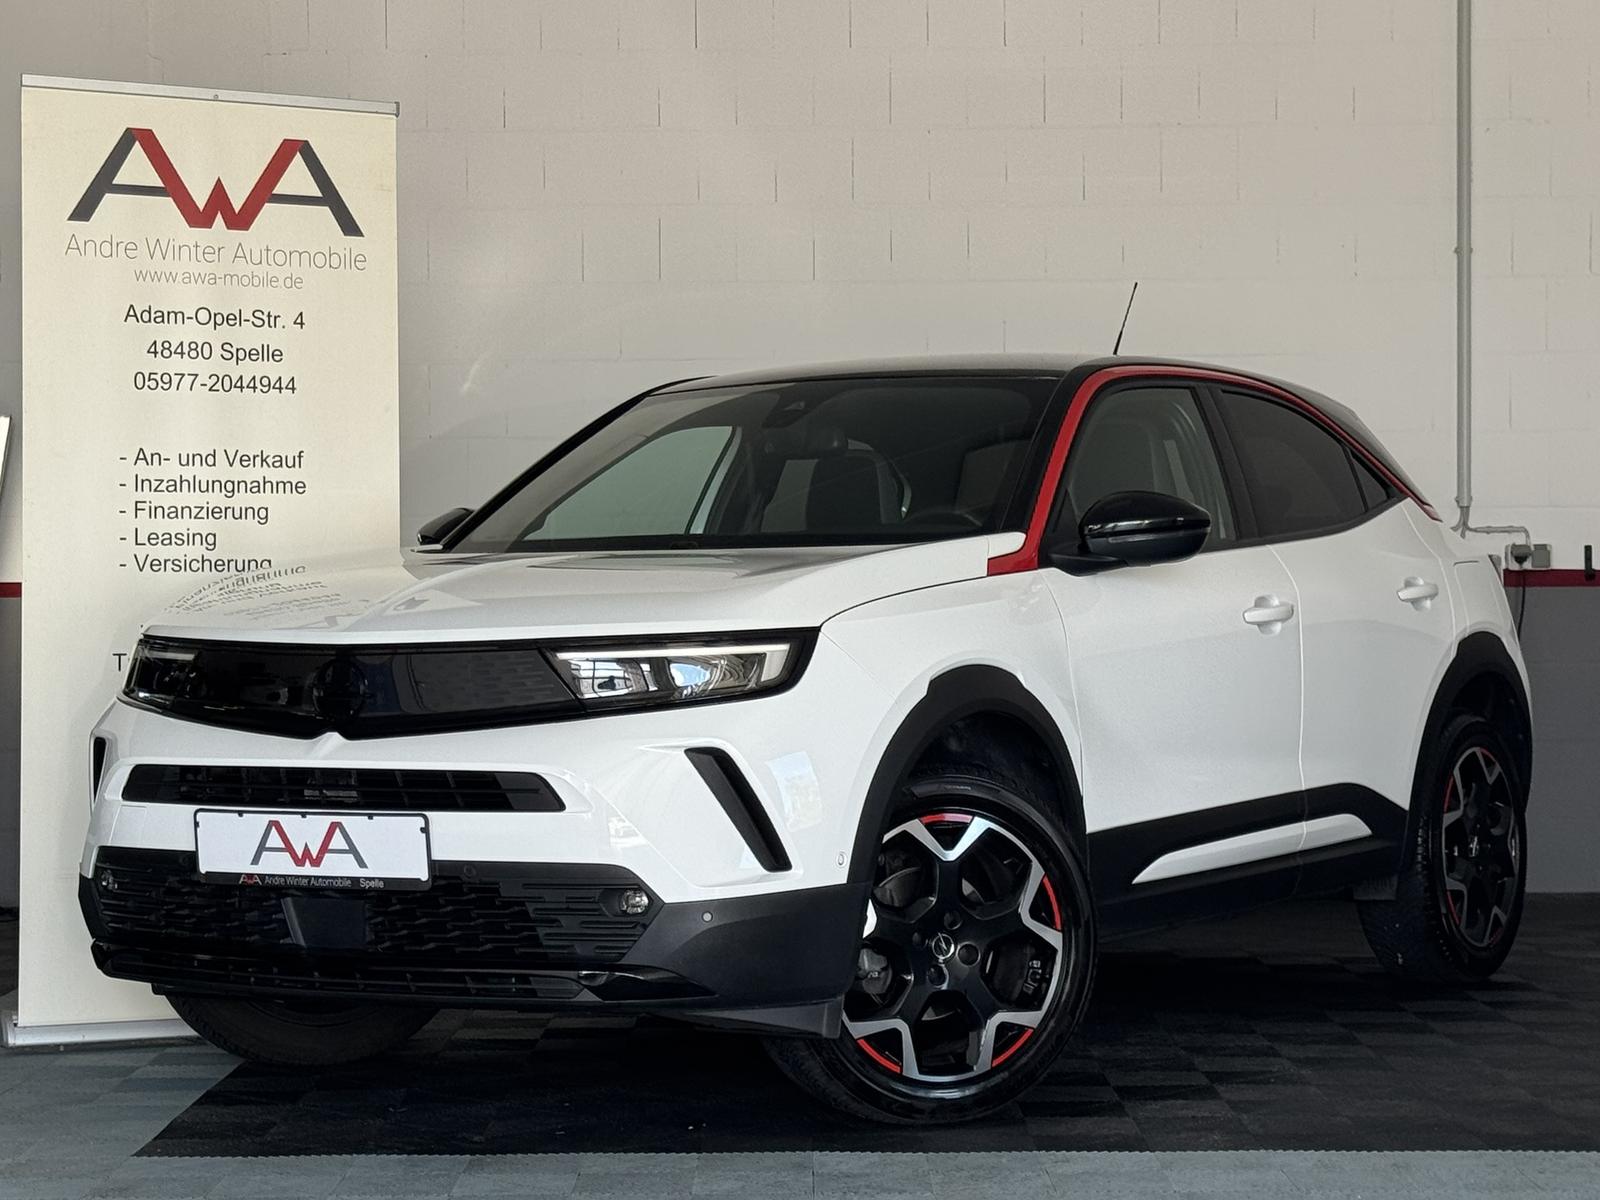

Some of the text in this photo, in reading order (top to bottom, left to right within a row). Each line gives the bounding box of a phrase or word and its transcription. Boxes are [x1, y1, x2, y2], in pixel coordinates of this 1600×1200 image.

[64, 233, 367, 271] Andre Winter Automobile
[134, 268, 304, 289] www.awa-mobile.de
[123, 304, 305, 330] Adam-Opel-Str. 4
[146, 340, 284, 365] 48480 Spelle
[133, 371, 297, 394] 05977-2044944
[133, 447, 171, 466] An-
[178, 449, 217, 467] und
[223, 449, 304, 469] Verkauf
[134, 474, 306, 498] Inzahlungnahme
[134, 500, 269, 525] Finanzierung
[134, 527, 217, 551] Leasing
[264, 875, 285, 886] Andre
[285, 876, 309, 886] Winter
[310, 877, 352, 888] Automobile
[359, 878, 385, 889] Spelle
